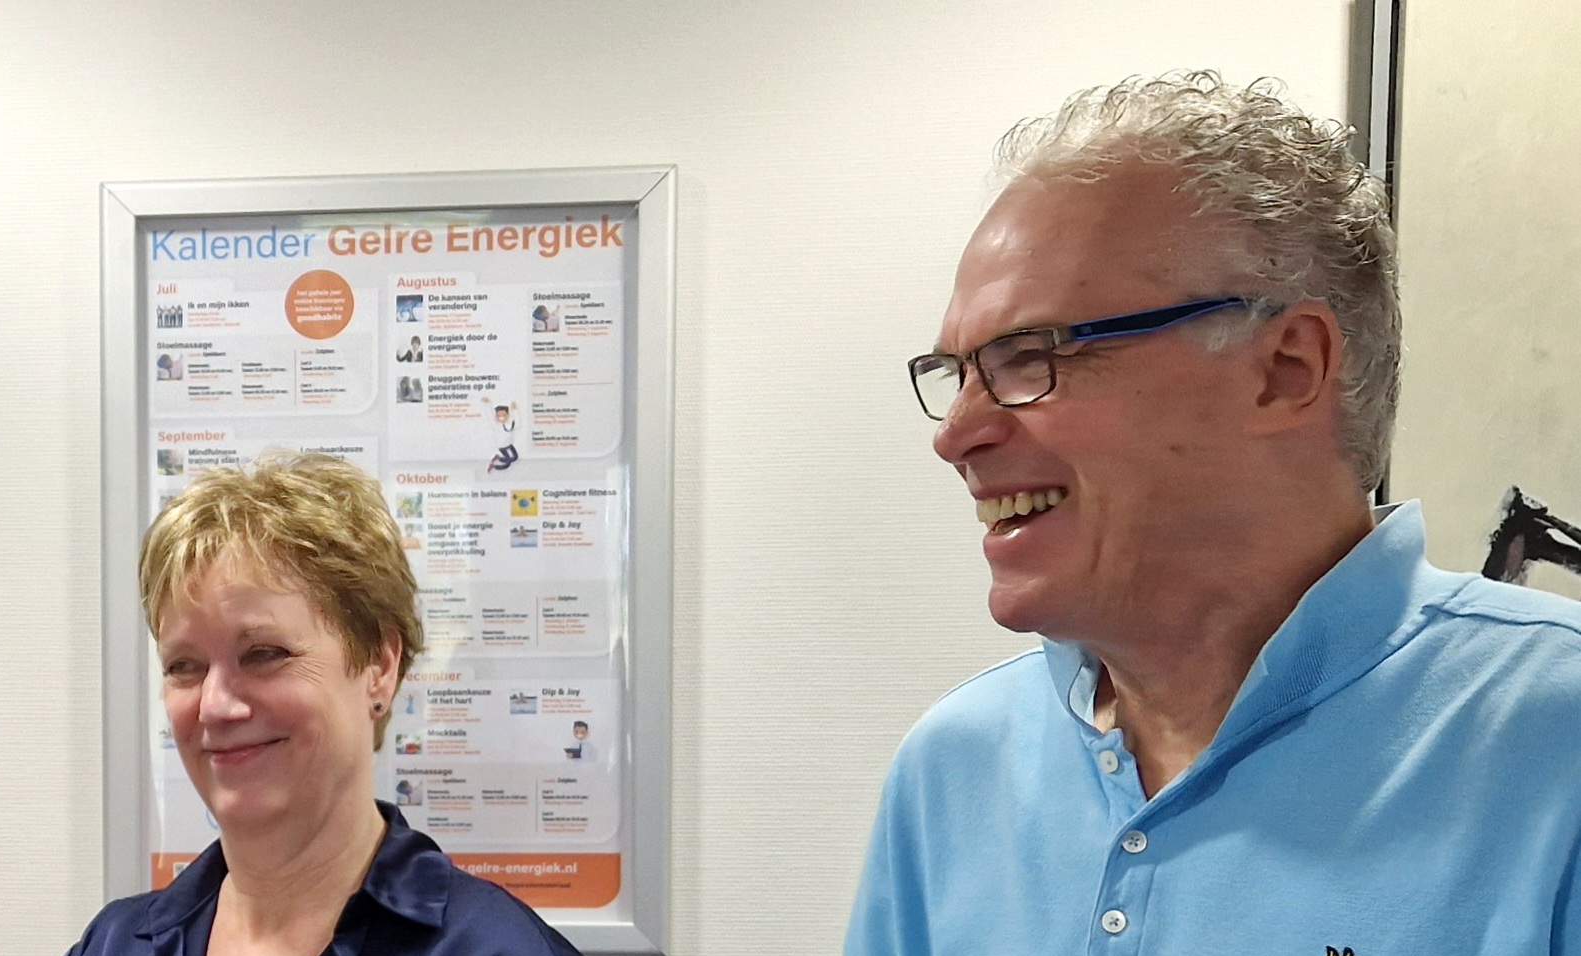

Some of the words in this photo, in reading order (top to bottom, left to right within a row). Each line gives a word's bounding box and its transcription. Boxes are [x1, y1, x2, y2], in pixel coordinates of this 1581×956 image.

[152, 225, 315, 261] Kalender
[328, 225, 432, 255] Gelre
[447, 214, 623, 258] Energiek
[397, 276, 456, 289] Augustus
[157, 283, 176, 294] Juli
[533, 293, 591, 301] Stoelmassage
[209, 301, 226, 309] mijn
[428, 302, 477, 311] verandering
[428, 334, 464, 343] Energiek
[466, 333, 485, 341] door
[157, 342, 213, 350] Stoelmassage
[428, 344, 466, 352] overgang
[428, 375, 463, 383] Bruggen
[428, 384, 471, 392] generaties
[485, 382, 496, 390] de
[158, 431, 226, 443] September
[188, 448, 237, 456] Mindfulness
[397, 473, 448, 484] Oktober
[428, 491, 469, 499] Hormonen
[471, 490, 479, 498] in
[481, 490, 507, 498] balans
[543, 489, 587, 498] Cognitieve
[589, 488, 617, 496] fitness
[543, 521, 557, 530] Dip
[568, 521, 581, 530] Joy
[406, 671, 461, 681] ecember
[428, 689, 491, 697] Loopbaankeuze
[542, 689, 556, 697] Dip
[568, 688, 580, 697] Joy
[428, 729, 467, 737] Mocktails
[396, 768, 453, 776] Stoelmassage
[458, 862, 577, 876] .gelre-energiek.nl
